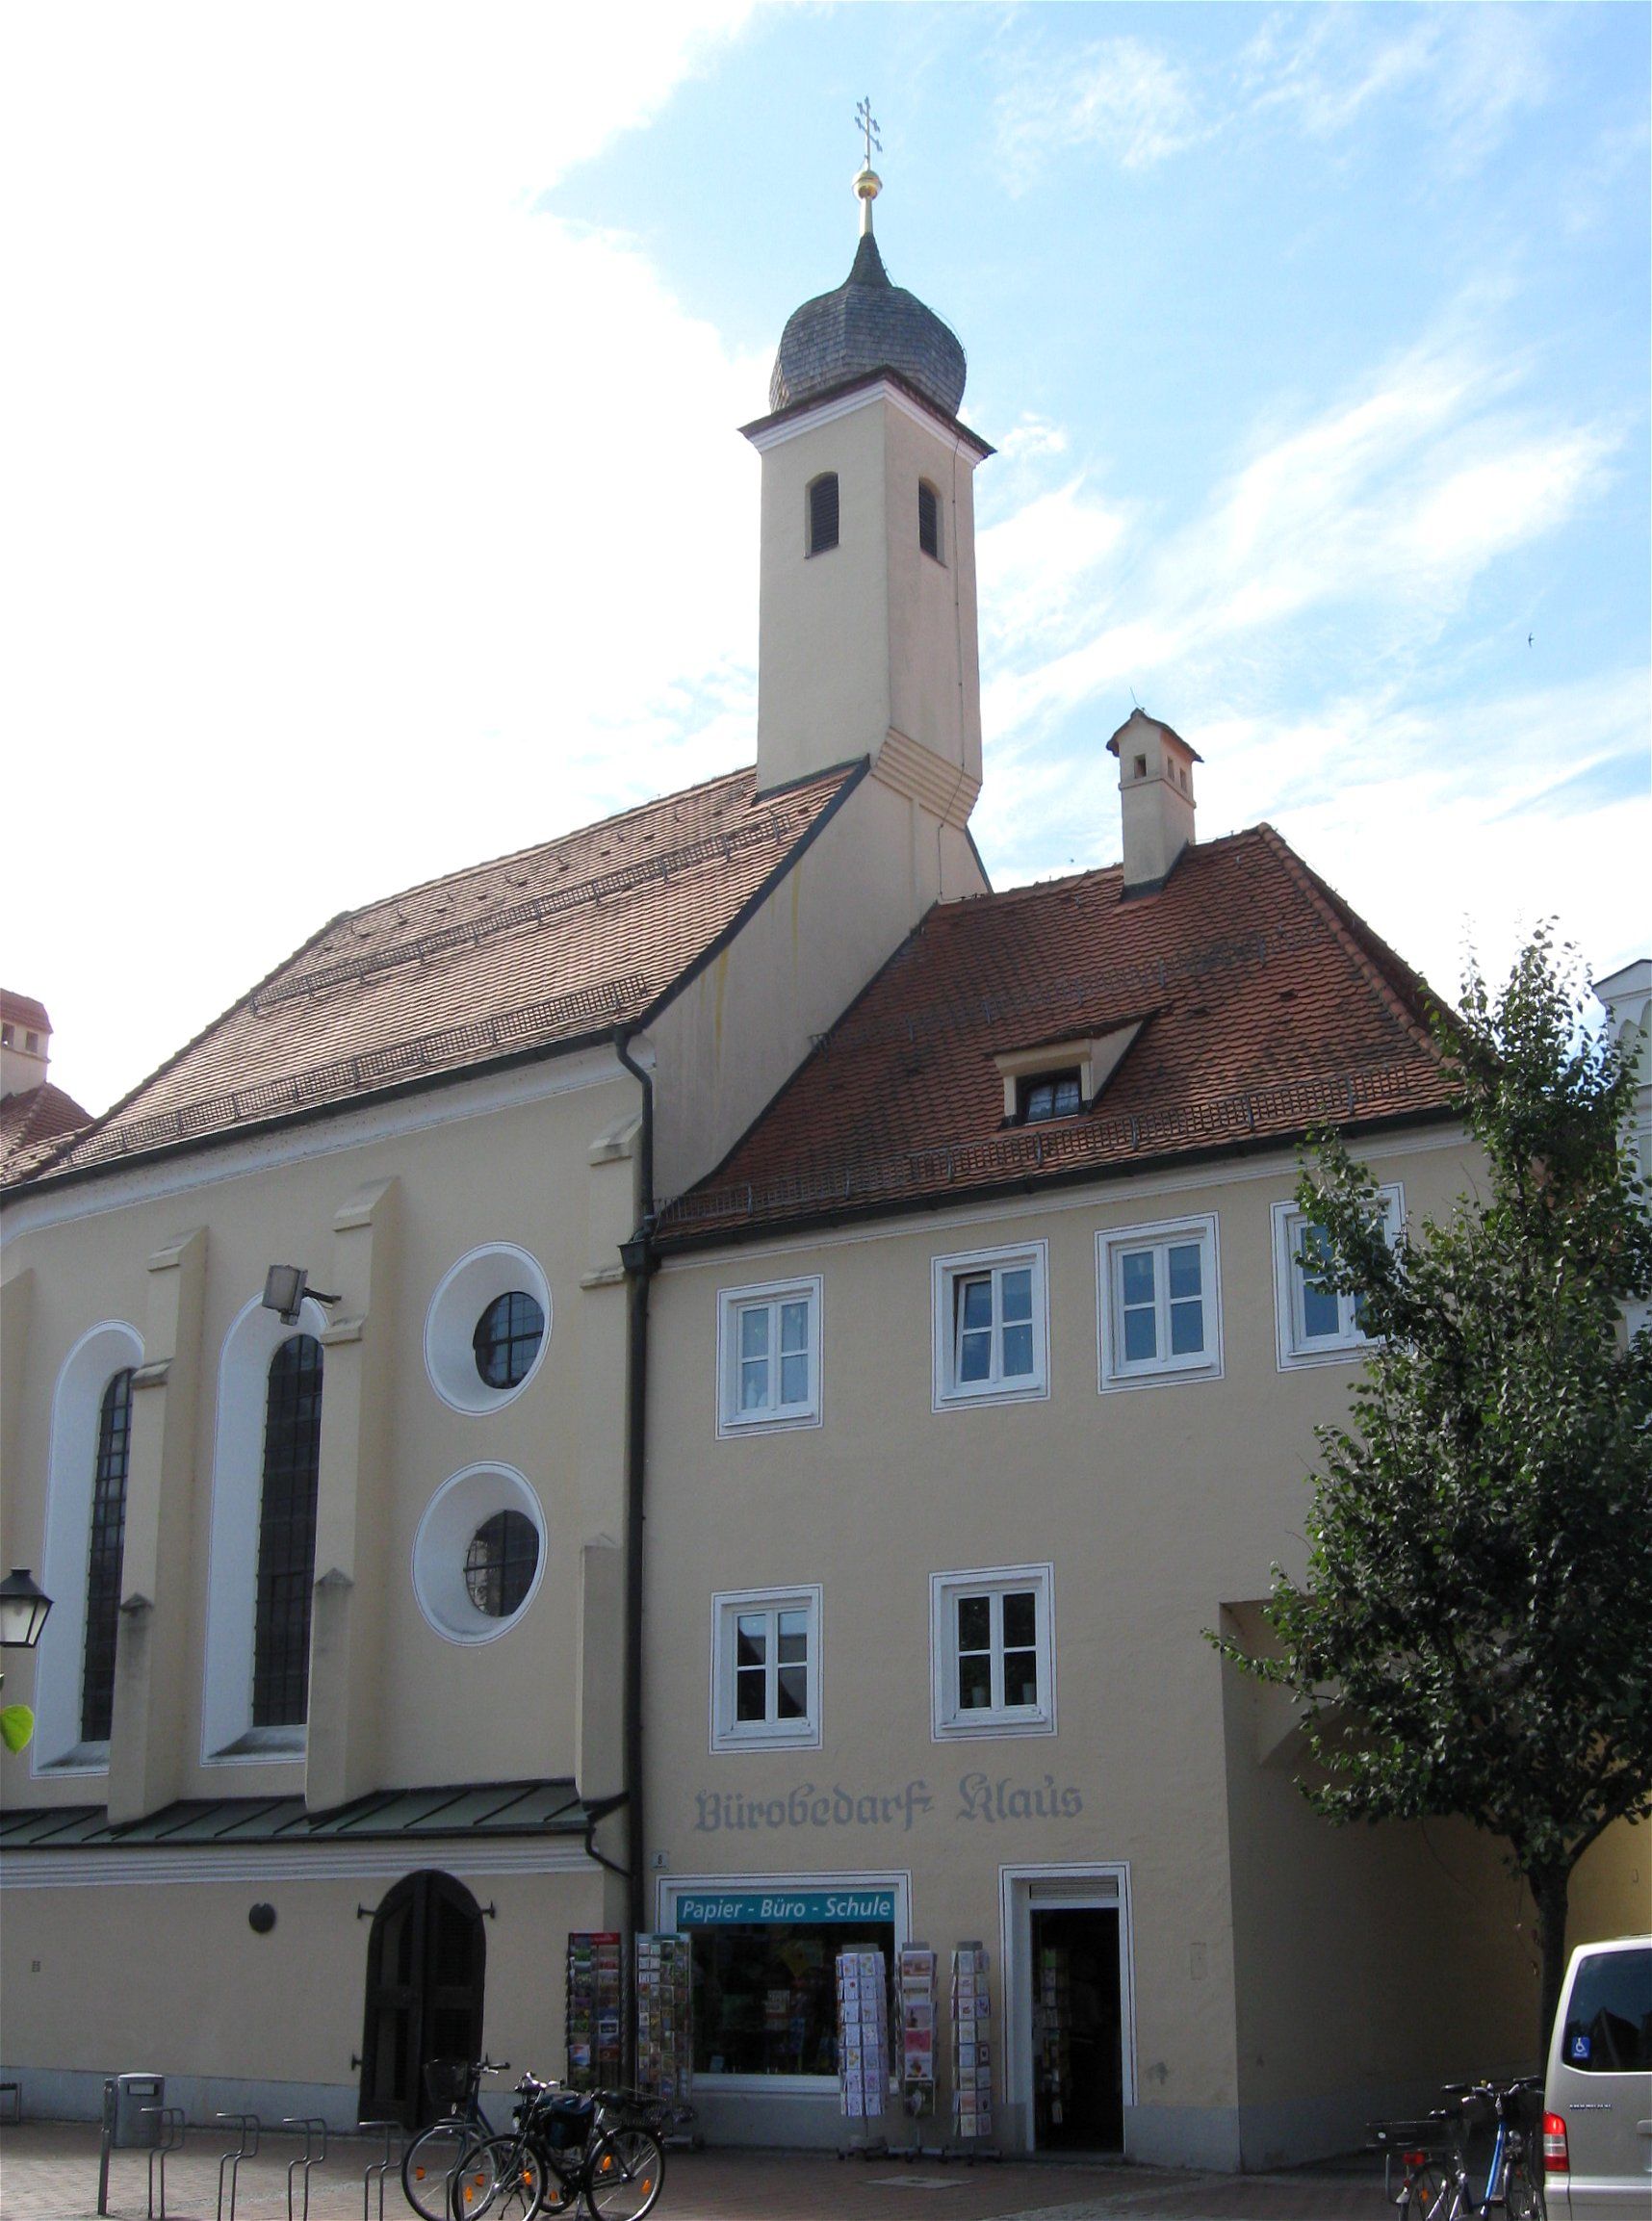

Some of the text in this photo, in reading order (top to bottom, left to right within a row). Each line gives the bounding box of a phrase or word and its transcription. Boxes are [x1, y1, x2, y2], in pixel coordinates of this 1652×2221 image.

[694, 1772, 1084, 1832] Bürobedarf Klaus
[683, 1899, 742, 1923] Papier
[761, 1898, 806, 1918] Büro
[825, 1896, 891, 1918] Schule
